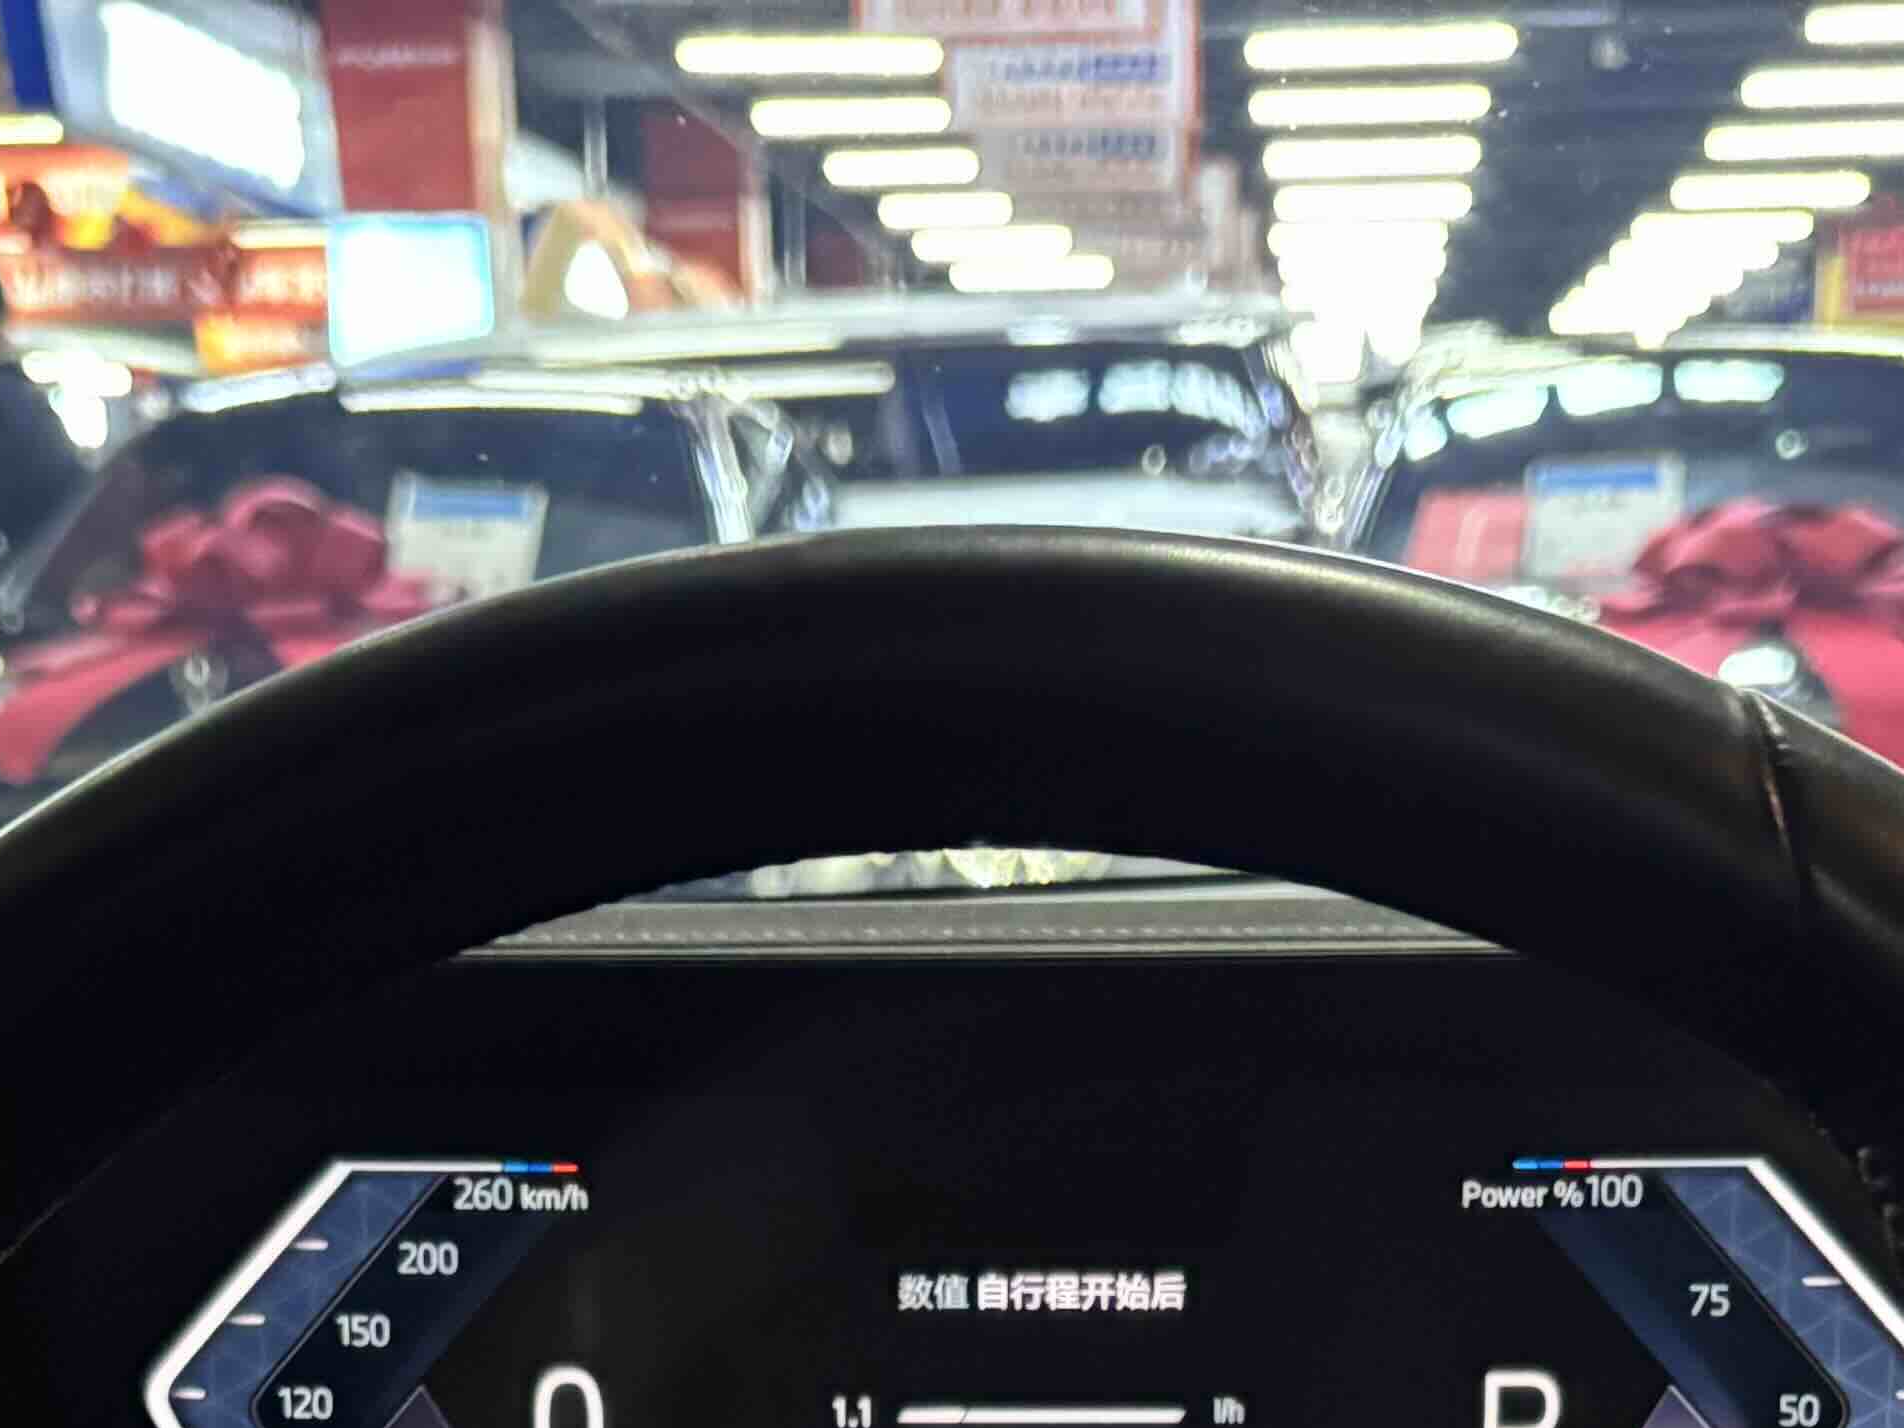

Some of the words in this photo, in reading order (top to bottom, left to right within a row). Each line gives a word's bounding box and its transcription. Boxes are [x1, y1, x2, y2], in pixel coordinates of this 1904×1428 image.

[454, 1177, 513, 1211] 260
[520, 1183, 589, 1211] km/h
[1462, 1180, 1549, 1209] Power
[398, 1241, 459, 1275] 200
[898, 1274, 969, 1310] 数值
[977, 1273, 1187, 1311] 自行程开始后
[1689, 1283, 1730, 1317] 75
[336, 1314, 391, 1348] 150
[278, 1386, 333, 1420] 120
[832, 1396, 872, 1428] 1.1
[1779, 1394, 1820, 1428] 50
